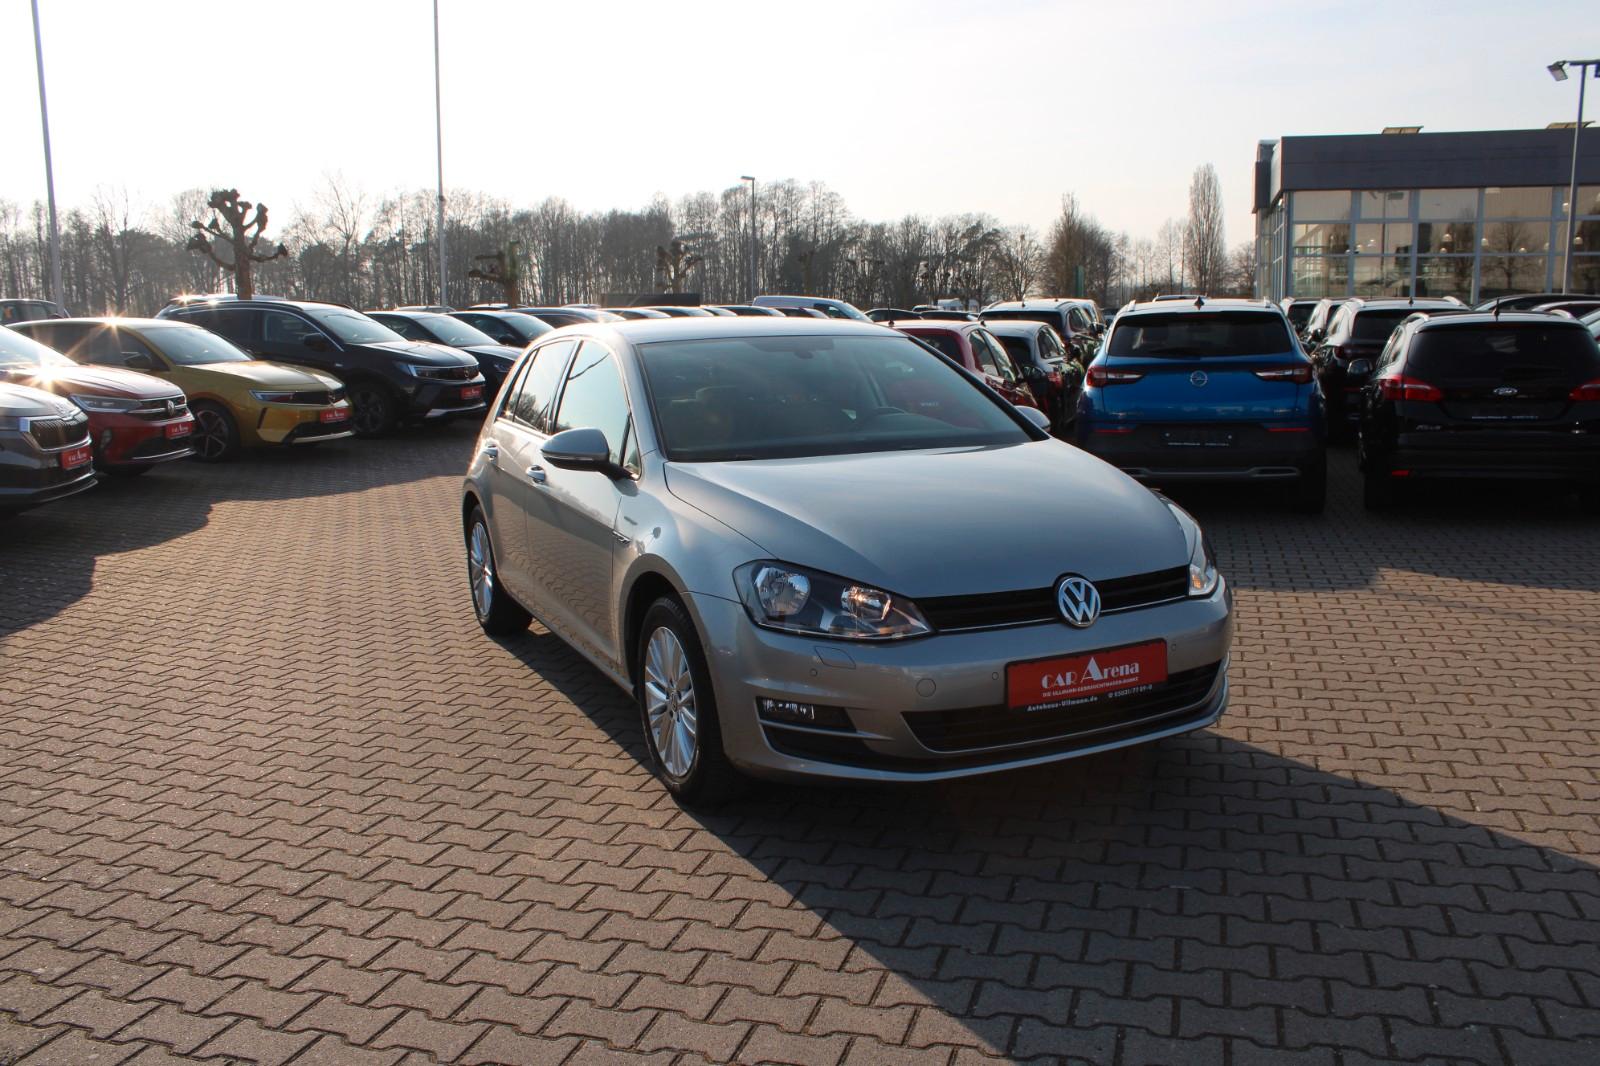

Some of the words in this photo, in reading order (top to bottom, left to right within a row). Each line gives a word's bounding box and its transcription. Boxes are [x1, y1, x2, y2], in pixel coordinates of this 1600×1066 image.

[1059, 577, 1101, 627] VW
[1041, 671, 1077, 689] CAR
[1080, 656, 1140, 683] Arena
